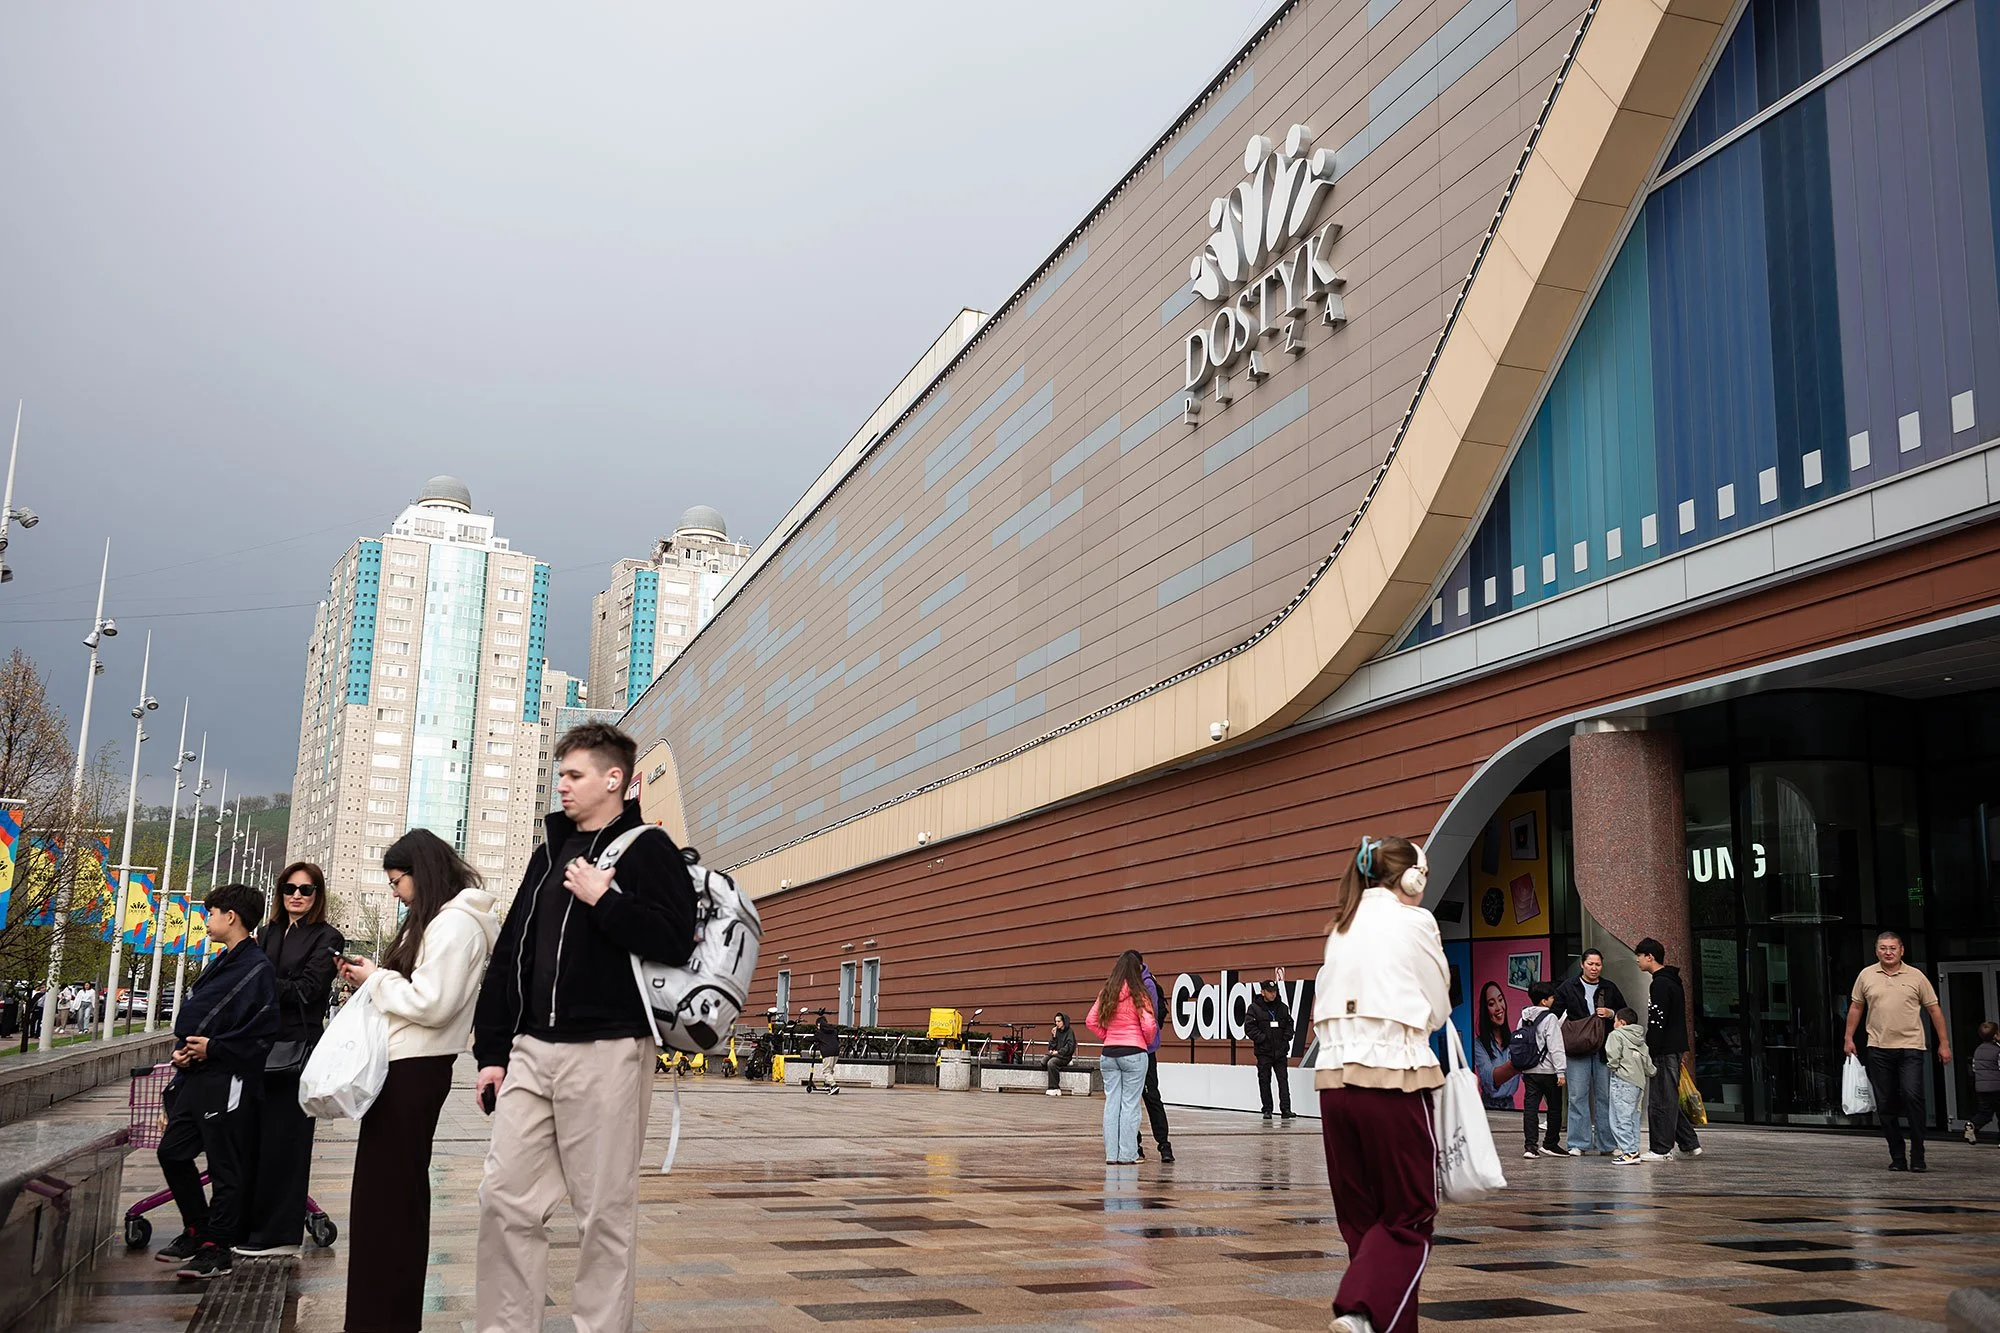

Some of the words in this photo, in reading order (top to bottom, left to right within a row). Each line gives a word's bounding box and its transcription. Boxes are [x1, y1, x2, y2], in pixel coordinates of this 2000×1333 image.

[1184, 222, 1346, 392] DOSTYK
[1184, 292, 1347, 425] PLAZA
[1687, 843, 1767, 883] UNG
